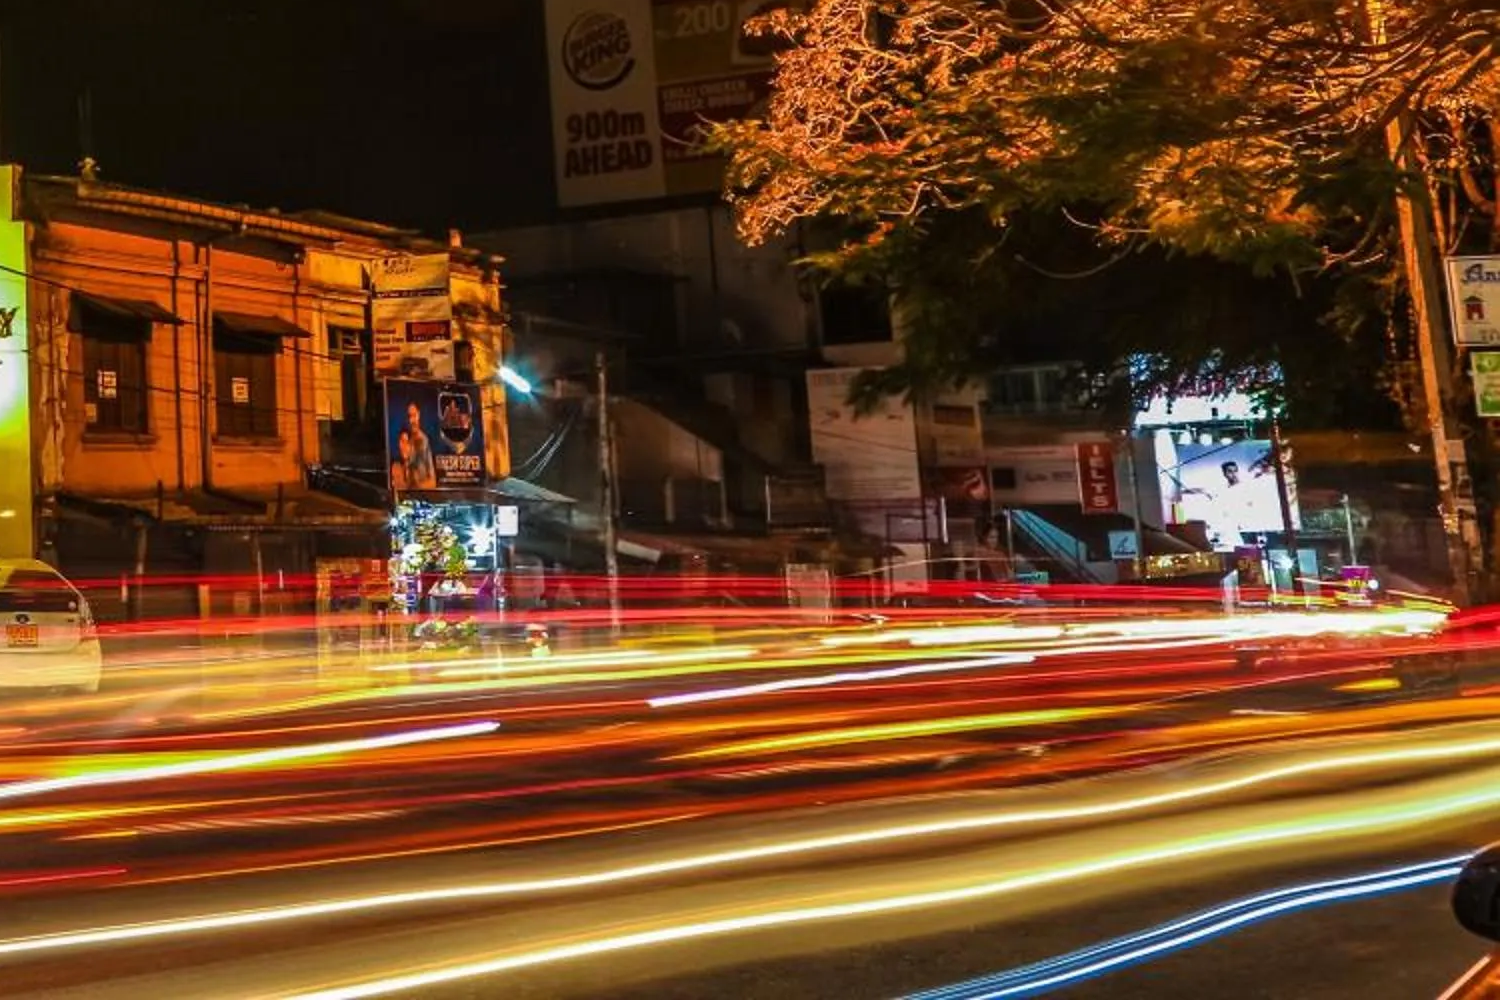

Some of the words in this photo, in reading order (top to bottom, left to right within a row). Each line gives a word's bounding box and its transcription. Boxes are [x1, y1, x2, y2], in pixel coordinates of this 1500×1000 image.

[674, 1, 730, 37] 200
[573, 32, 631, 73] KING
[566, 109, 645, 142] 900m
[564, 140, 652, 178] AHEAD
[1089, 444, 1109, 507] IELTS
